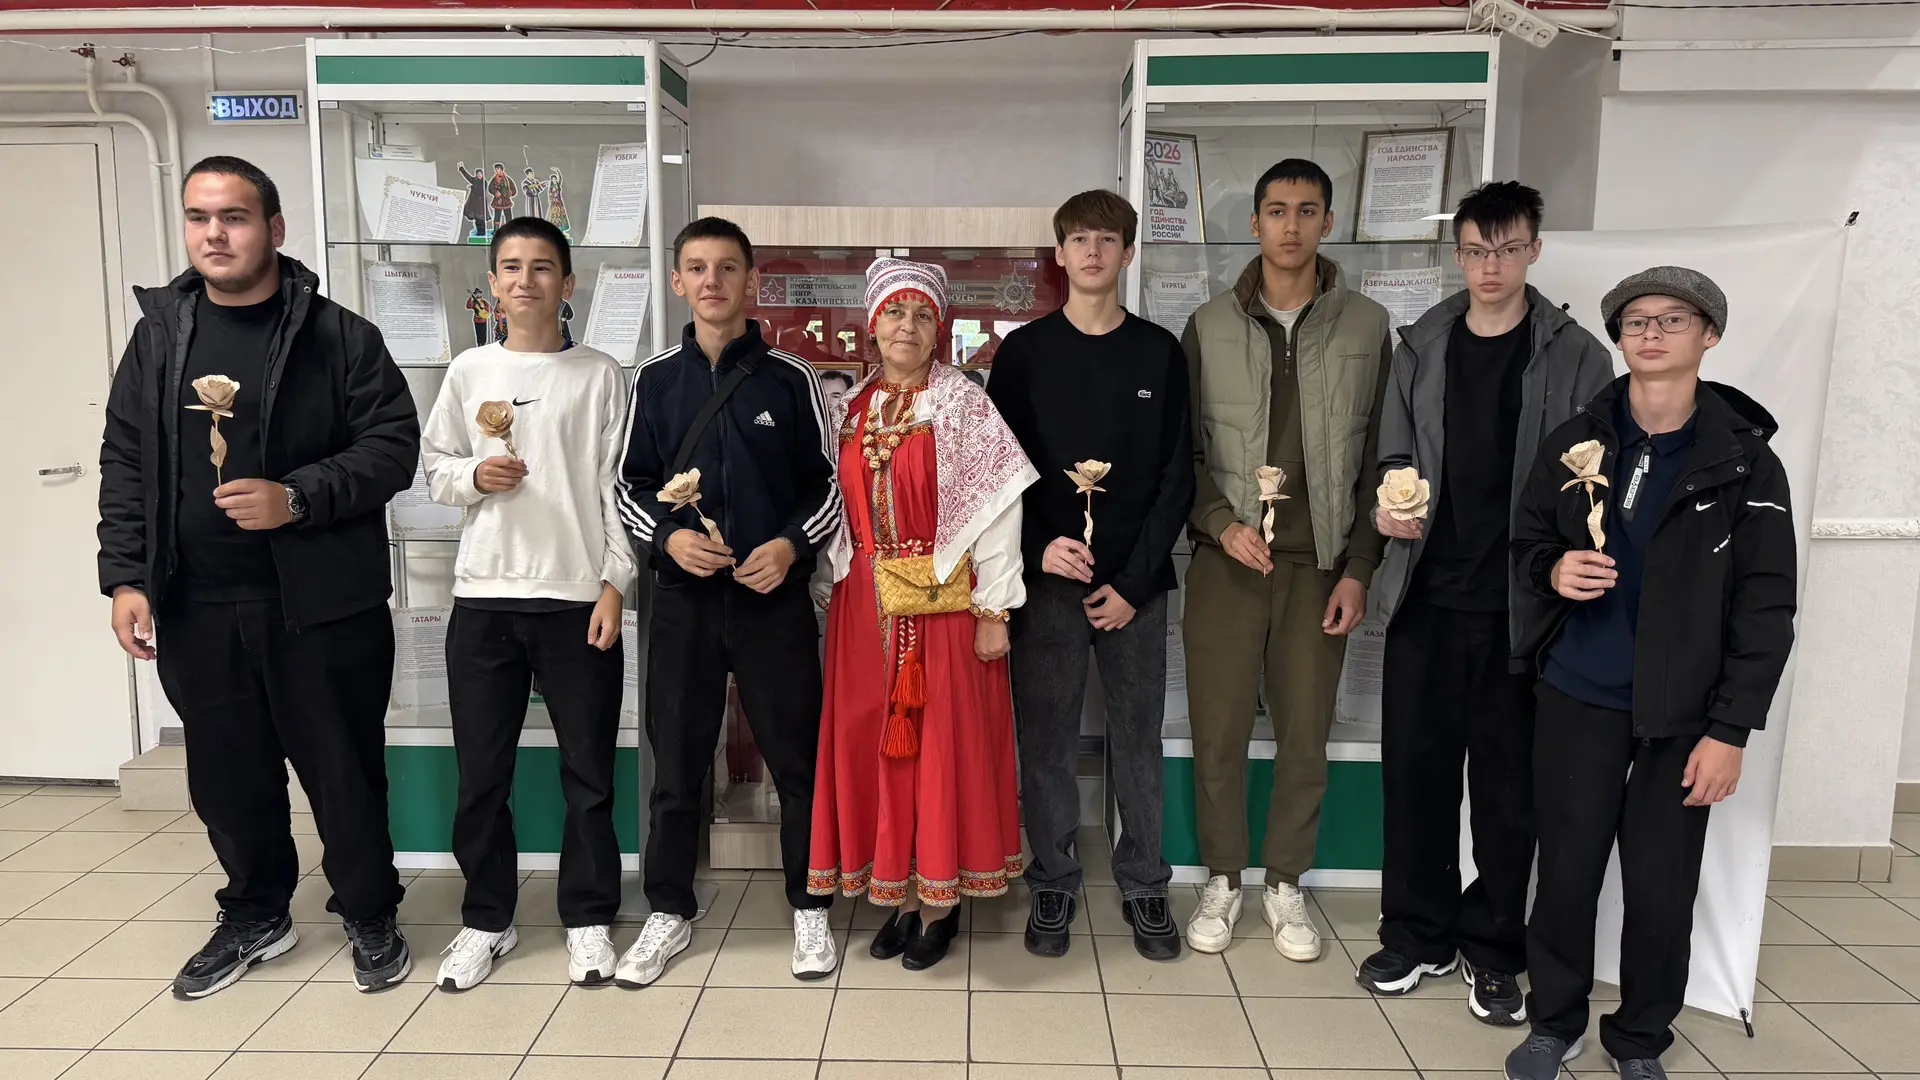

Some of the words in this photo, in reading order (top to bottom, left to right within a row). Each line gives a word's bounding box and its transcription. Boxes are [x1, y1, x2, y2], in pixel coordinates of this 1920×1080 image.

[216, 97, 296, 118] ВЫХОД
[1145, 141, 1181, 160] 2026
[1395, 144, 1438, 153] ЕДИНСТВА
[614, 153, 638, 161] УЗБЕКИ
[1386, 154, 1427, 162] НАРОДОВ
[410, 189, 439, 203] ЧУКЧИ
[1149, 208, 1165, 216] ГОД
[1150, 215, 1187, 225] ЕДИНСТВА
[1151, 223, 1185, 232] НАРОДОВ
[1152, 230, 1182, 239] РОССИИ
[384, 270, 419, 279] ЦЫГАНЕ
[613, 272, 645, 280] КАЛМЫКИ
[789, 282, 858, 290] ПРОСВЕТИТЕЛЬСКИЙ
[1161, 281, 1187, 289] БУРЯТЫ
[1363, 277, 1440, 287] АЗЕРБАЙДЖАНЦЫ
[946, 283, 966, 291] НЮ!
[789, 290, 812, 298] ЦЕНТР
[790, 296, 864, 305] «КАЗАЧИНСКИЙ»
[753, 418, 776, 427] adidas
[410, 615, 442, 623] ТАТАРЫ
[623, 619, 638, 628] БЕЛО
[1364, 630, 1385, 638] КАЗА
